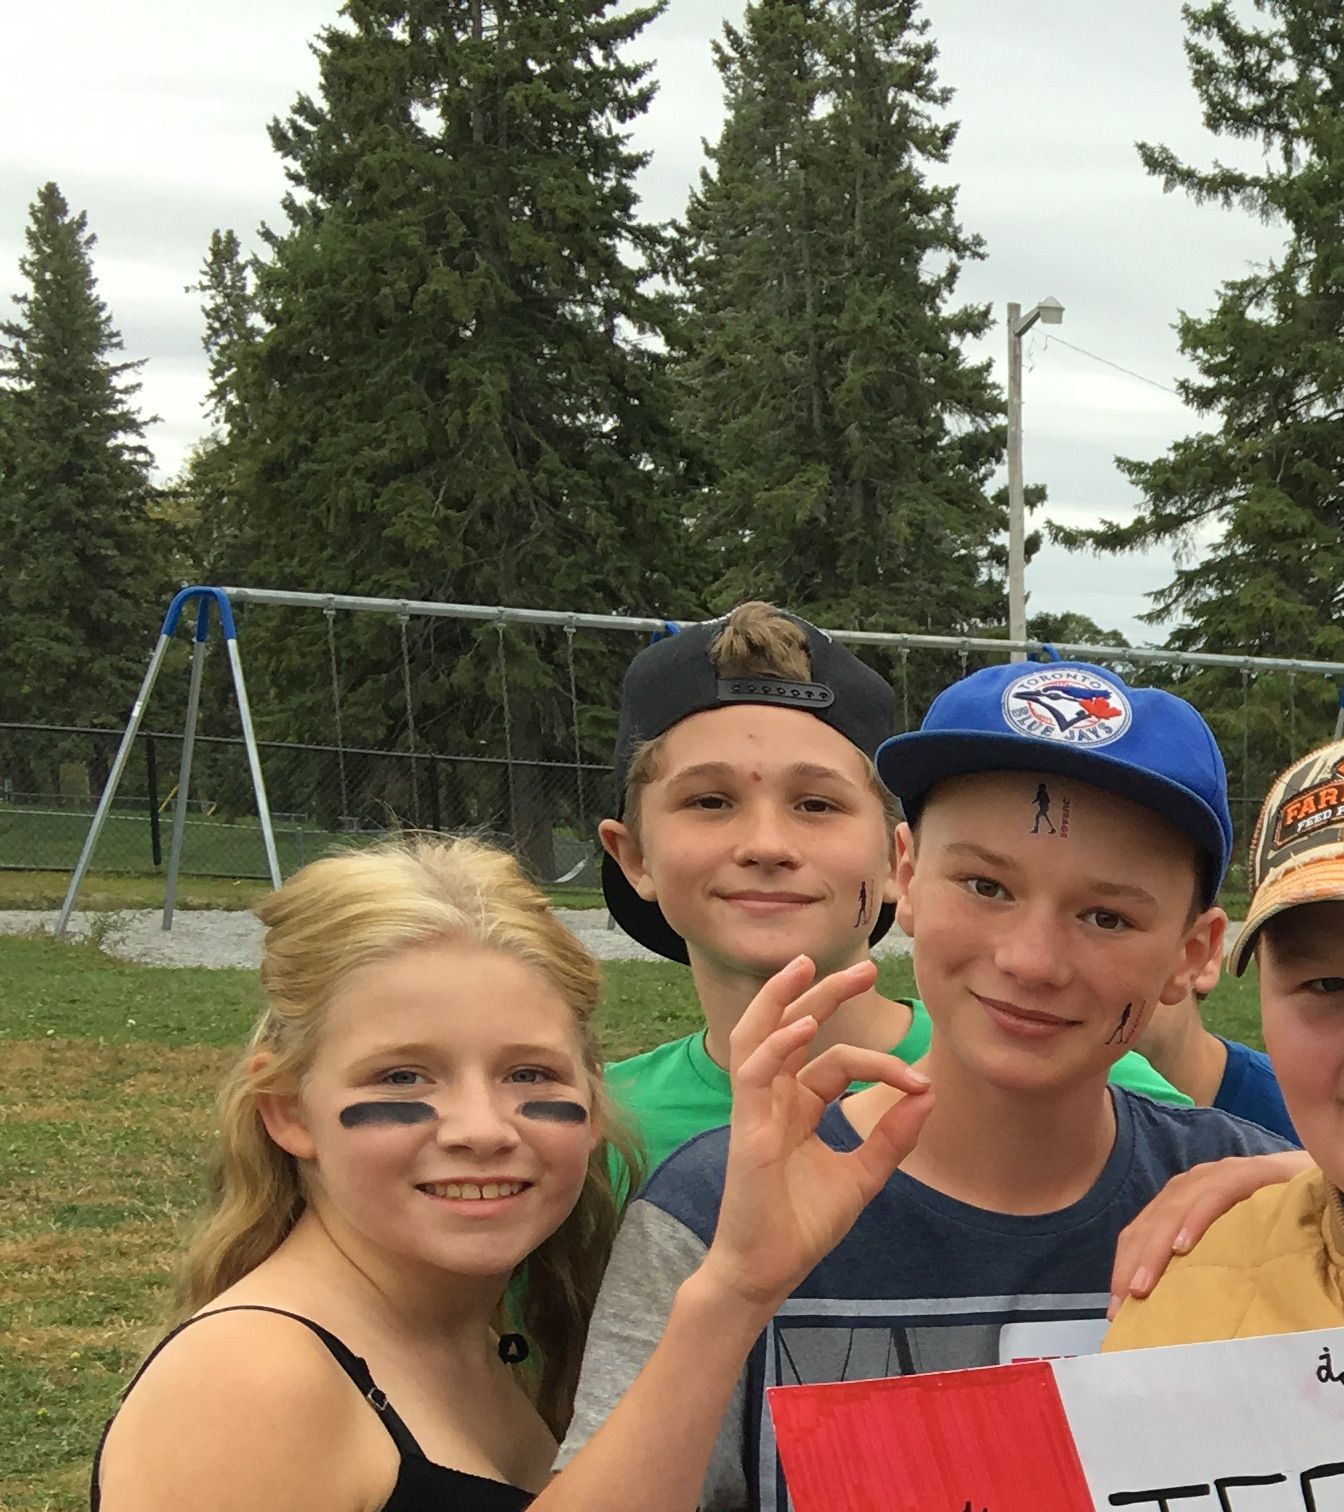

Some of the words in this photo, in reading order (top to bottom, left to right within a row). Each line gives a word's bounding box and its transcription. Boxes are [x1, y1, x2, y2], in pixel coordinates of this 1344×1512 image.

[1018, 672, 1102, 690] TORONTO
[1011, 705, 1055, 737] BLUE
[1064, 721, 1114, 741] JAYS
[1296, 808, 1333, 833] FEED
